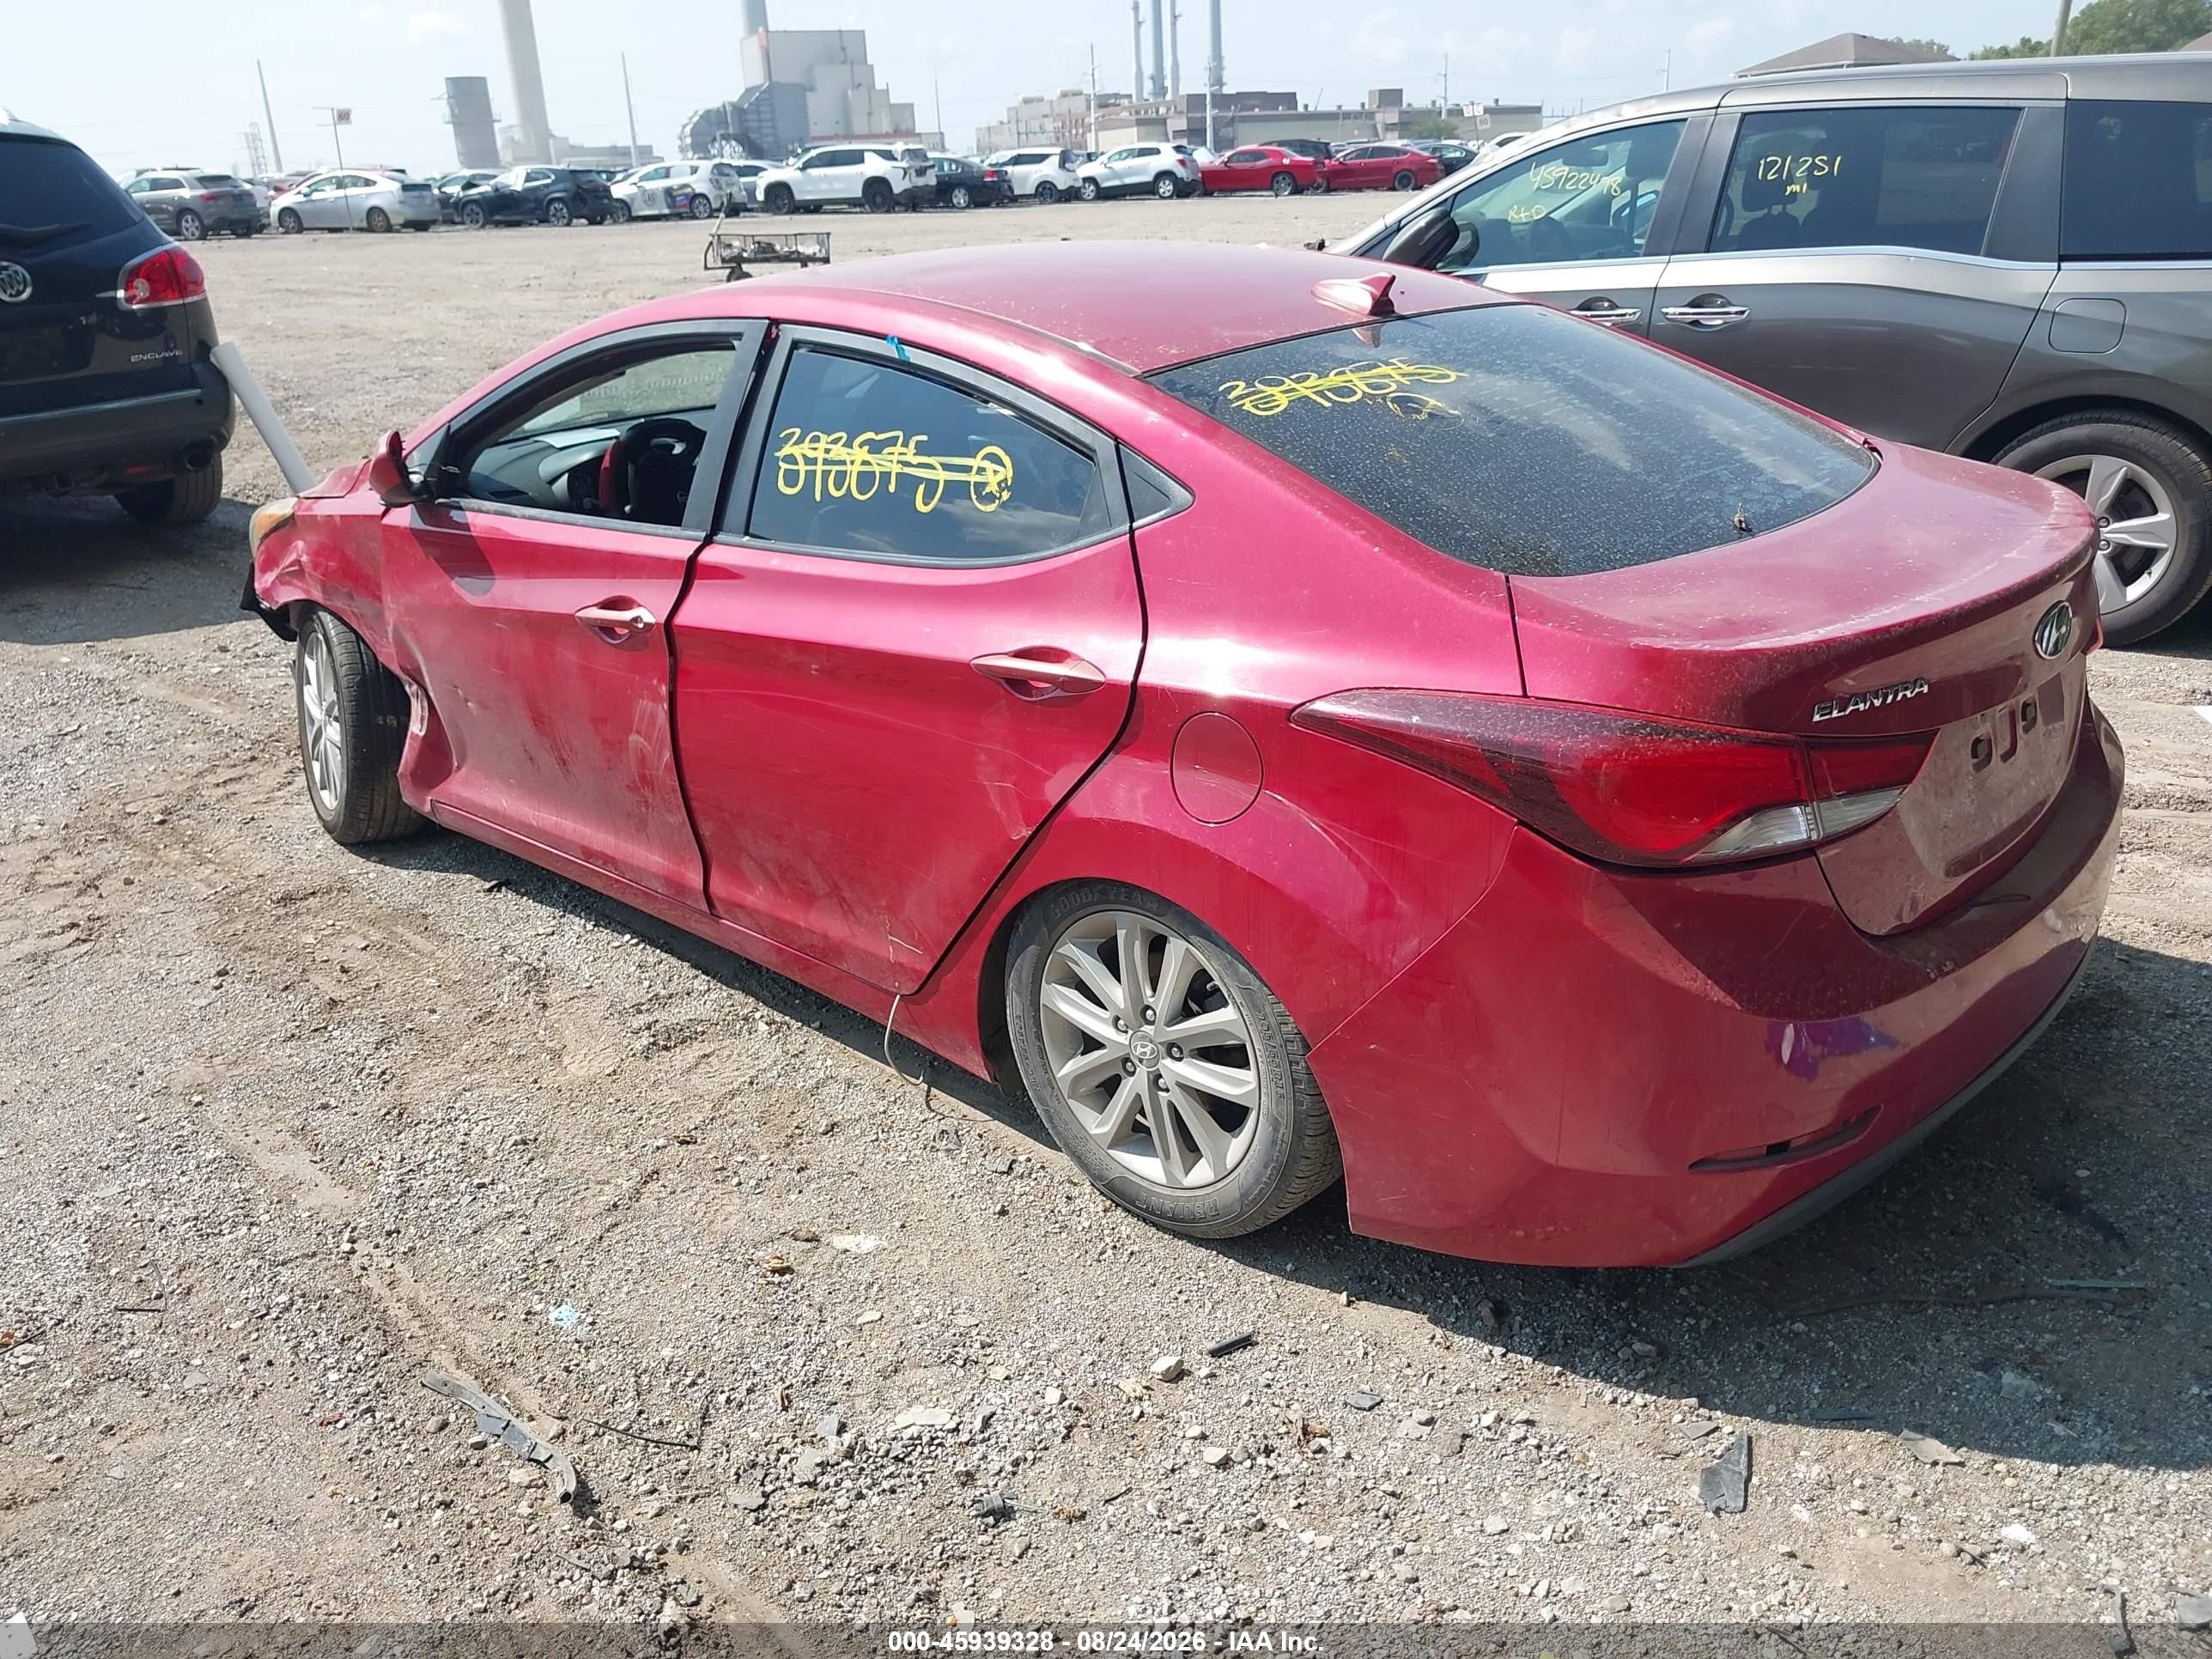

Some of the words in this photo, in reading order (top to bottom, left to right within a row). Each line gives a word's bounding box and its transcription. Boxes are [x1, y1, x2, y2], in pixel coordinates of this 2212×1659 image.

[1758, 155, 1841, 180] 121251
[131, 349, 184, 362] ENCLAVE
[1812, 677, 1929, 722] ELANTRA
[1134, 1192, 1220, 1219] RELIANT
